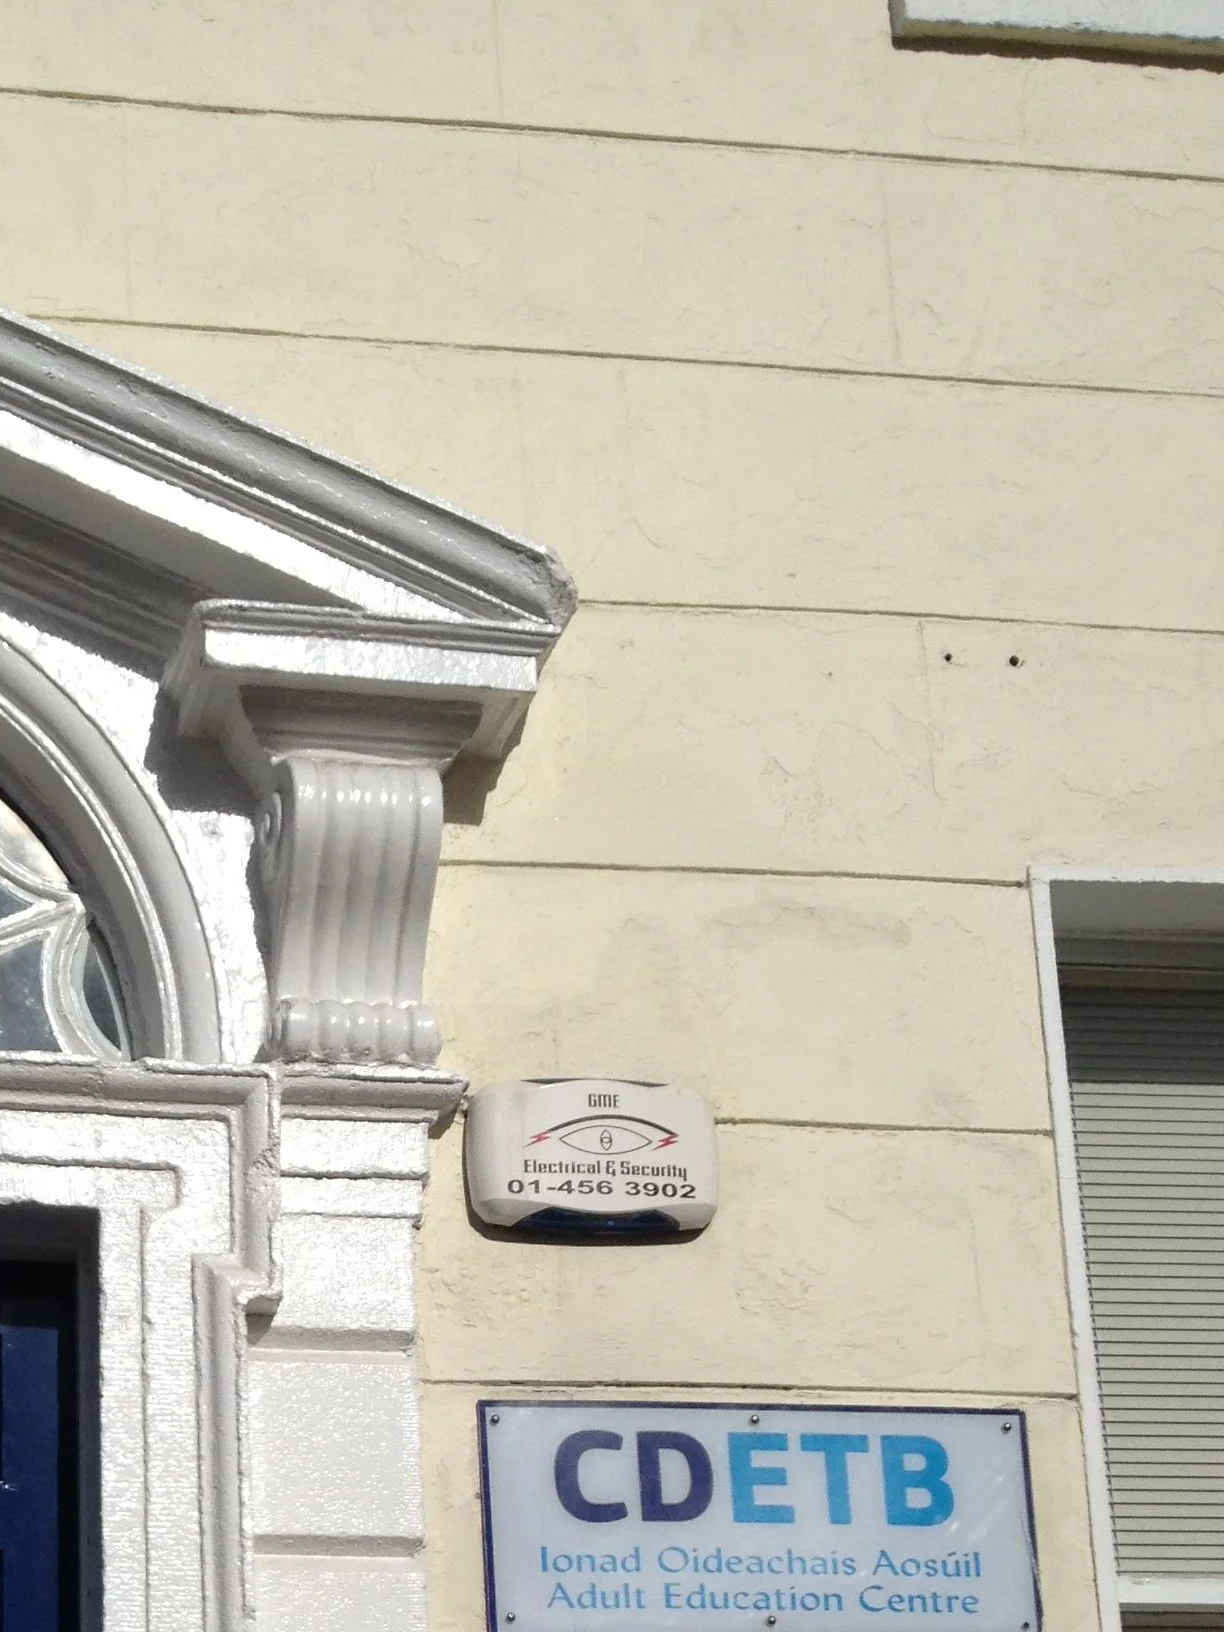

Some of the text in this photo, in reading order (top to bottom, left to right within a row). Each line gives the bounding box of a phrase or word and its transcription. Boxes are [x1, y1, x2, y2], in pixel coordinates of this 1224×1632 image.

[588, 1093, 620, 1108] GME
[524, 1159, 688, 1181] Electrical & Security
[507, 1179, 697, 1199] 01-456 3902
[554, 1429, 956, 1527] CDETB
[541, 1546, 982, 1578] Ionad Oideachais Aosúil
[547, 1582, 981, 1614] Adult Education Centre
